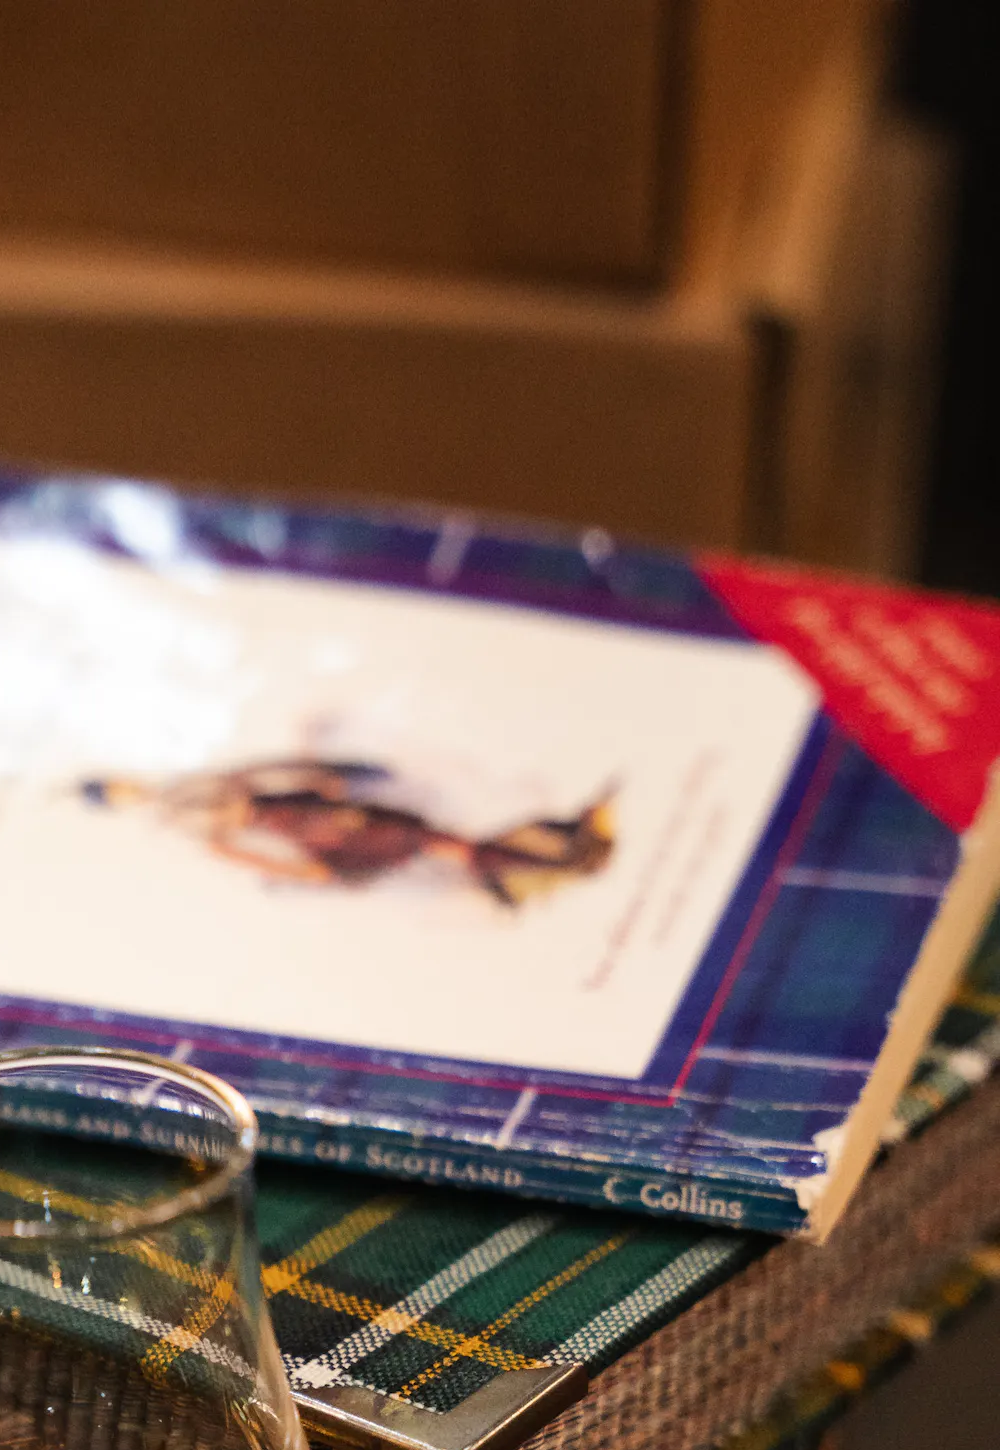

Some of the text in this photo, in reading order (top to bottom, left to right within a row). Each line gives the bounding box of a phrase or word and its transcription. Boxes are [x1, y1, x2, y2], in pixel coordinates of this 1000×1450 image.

[315, 1140, 352, 1165] OF
[366, 1143, 524, 1188] SCOTLAND
[640, 1183, 744, 1219] Collins
